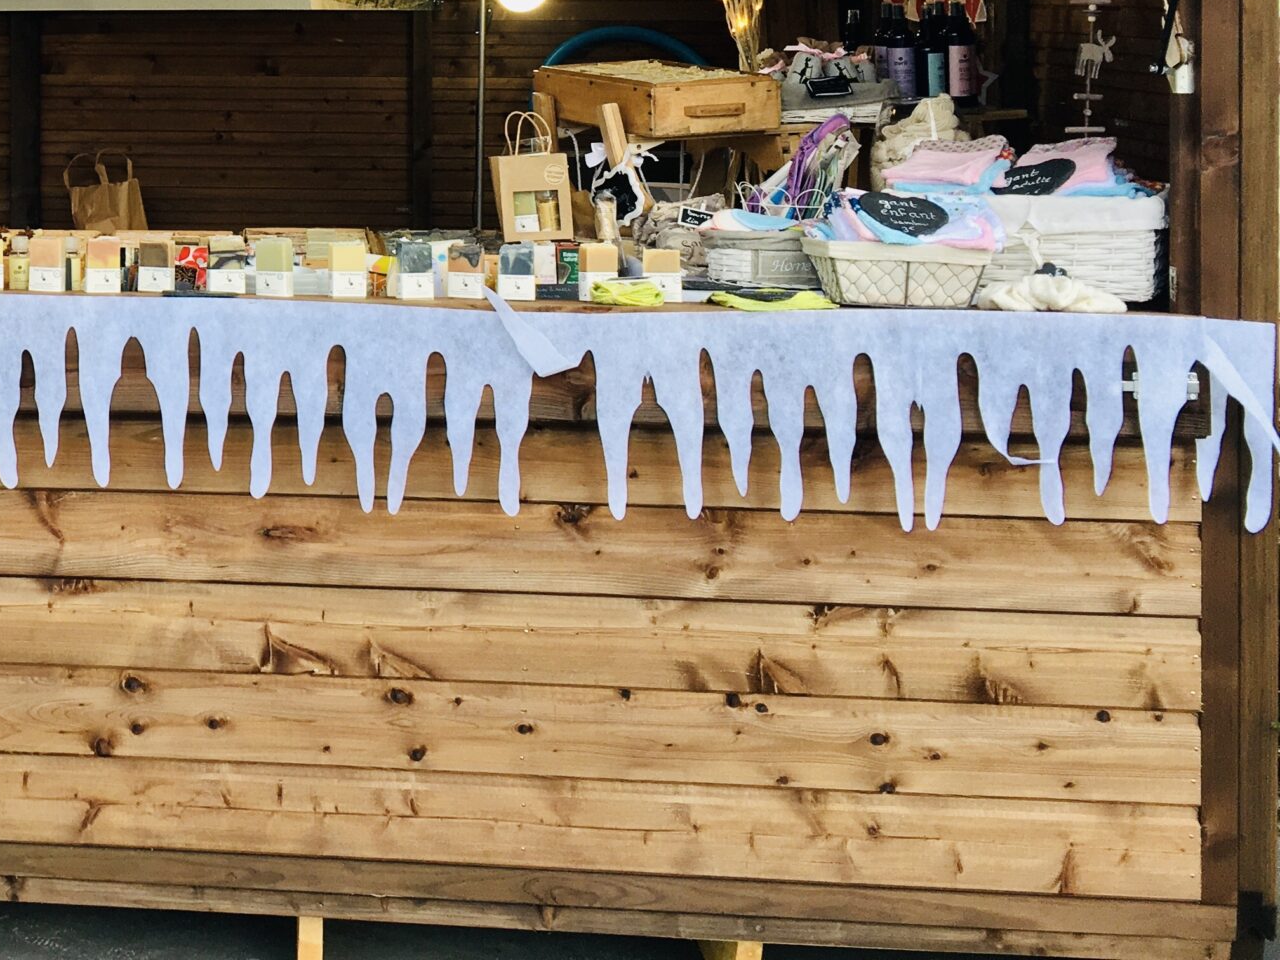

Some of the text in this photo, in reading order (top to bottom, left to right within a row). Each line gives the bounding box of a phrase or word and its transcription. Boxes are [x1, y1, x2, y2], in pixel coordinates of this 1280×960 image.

[878, 199, 918, 209] gant
[880, 208, 936, 220] enfant
[771, 259, 813, 272] Home
